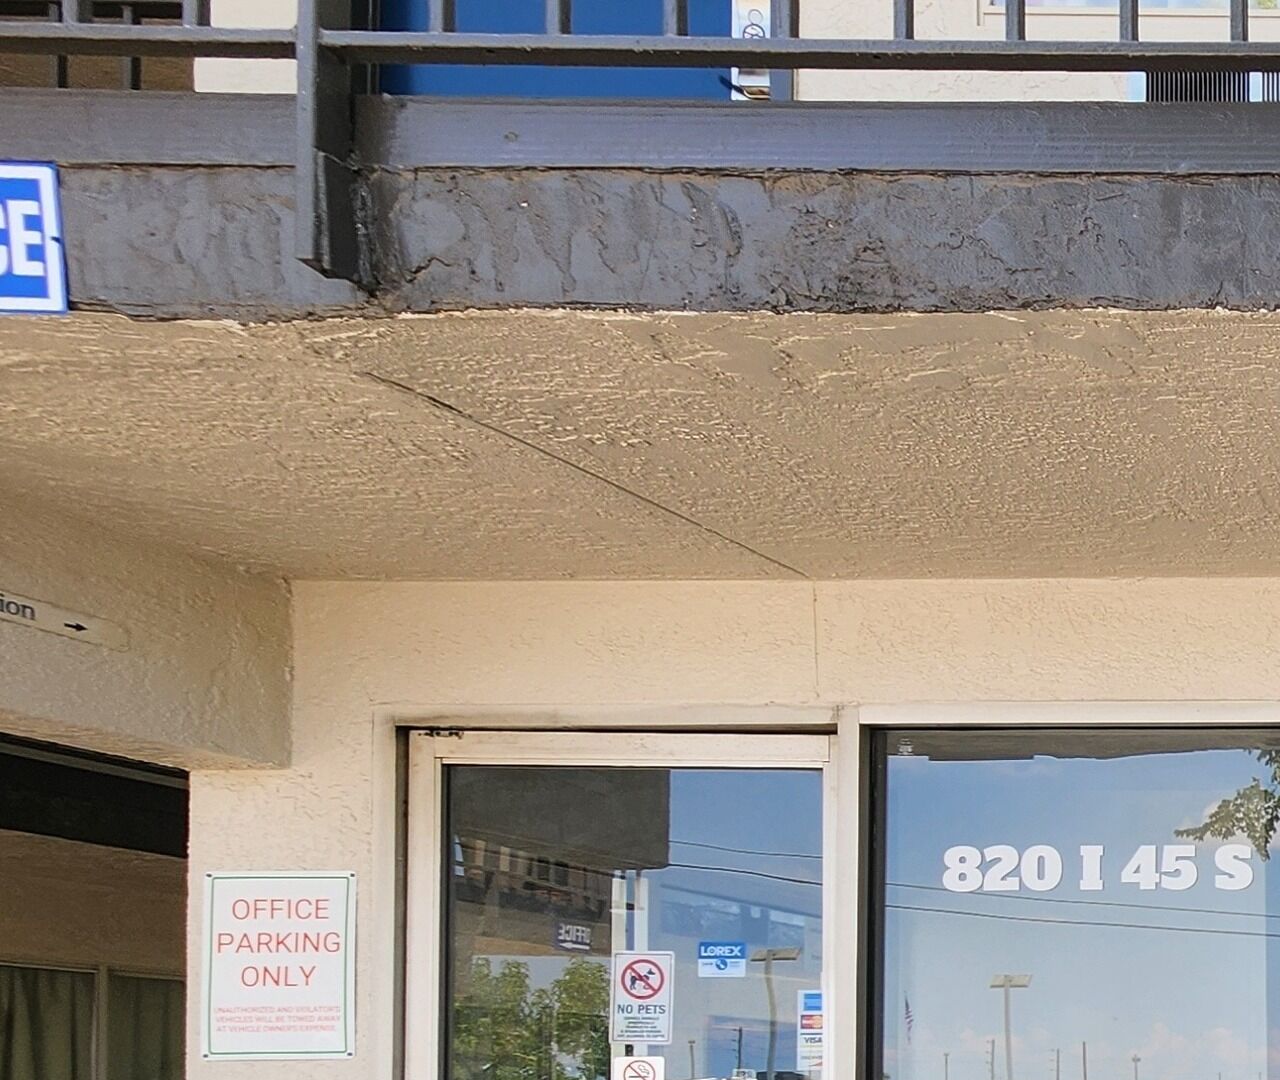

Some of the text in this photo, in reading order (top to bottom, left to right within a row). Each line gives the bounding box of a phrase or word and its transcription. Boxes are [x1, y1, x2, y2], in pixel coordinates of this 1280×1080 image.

[0, 200, 46, 276] E
[942, 844, 1254, 892] 820 I 45 S
[232, 898, 330, 920] OFFICE
[217, 932, 341, 953] PARKING
[701, 946, 742, 956] LOREX
[241, 965, 316, 987] ONLY
[617, 1004, 666, 1014] NO PETS
